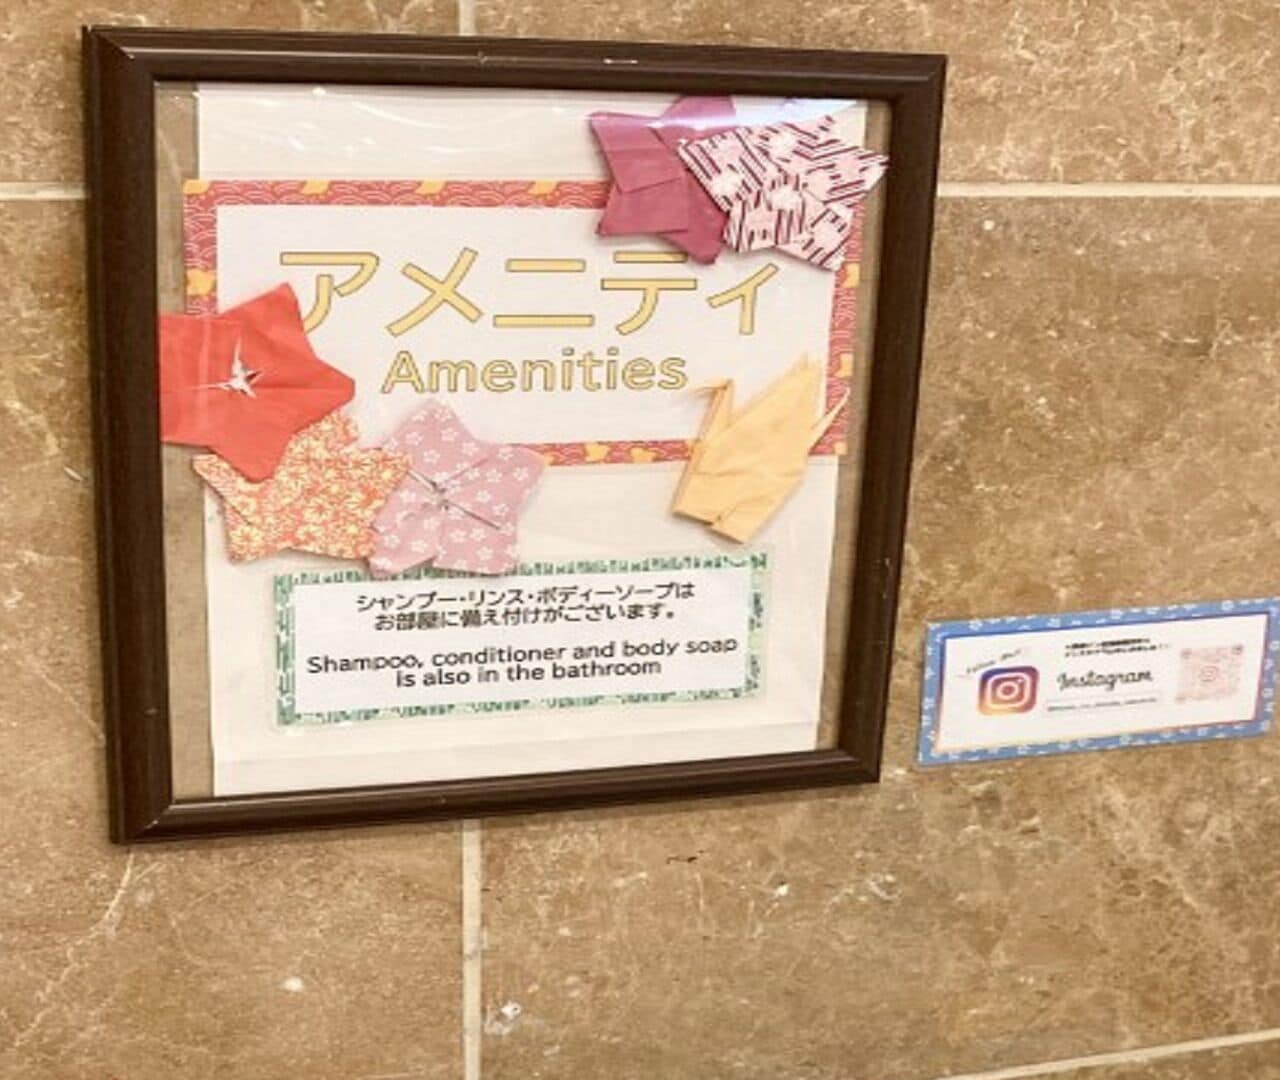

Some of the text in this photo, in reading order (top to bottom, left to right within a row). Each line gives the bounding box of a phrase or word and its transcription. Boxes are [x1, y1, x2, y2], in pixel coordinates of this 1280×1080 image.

[279, 247, 779, 335] アメニティ
[381, 348, 688, 394] Amenities
[357, 583, 695, 613] シャンプー・リンス・ボディーソープは
[375, 603, 675, 631] お部屋に備え付けがございます。
[431, 645, 565, 667] conditioner
[573, 642, 615, 659] and
[623, 639, 677, 659] body
[685, 637, 738, 656] soap
[396, 660, 662, 688] is also in the bathroom
[1057, 669, 1154, 691] Instagram
